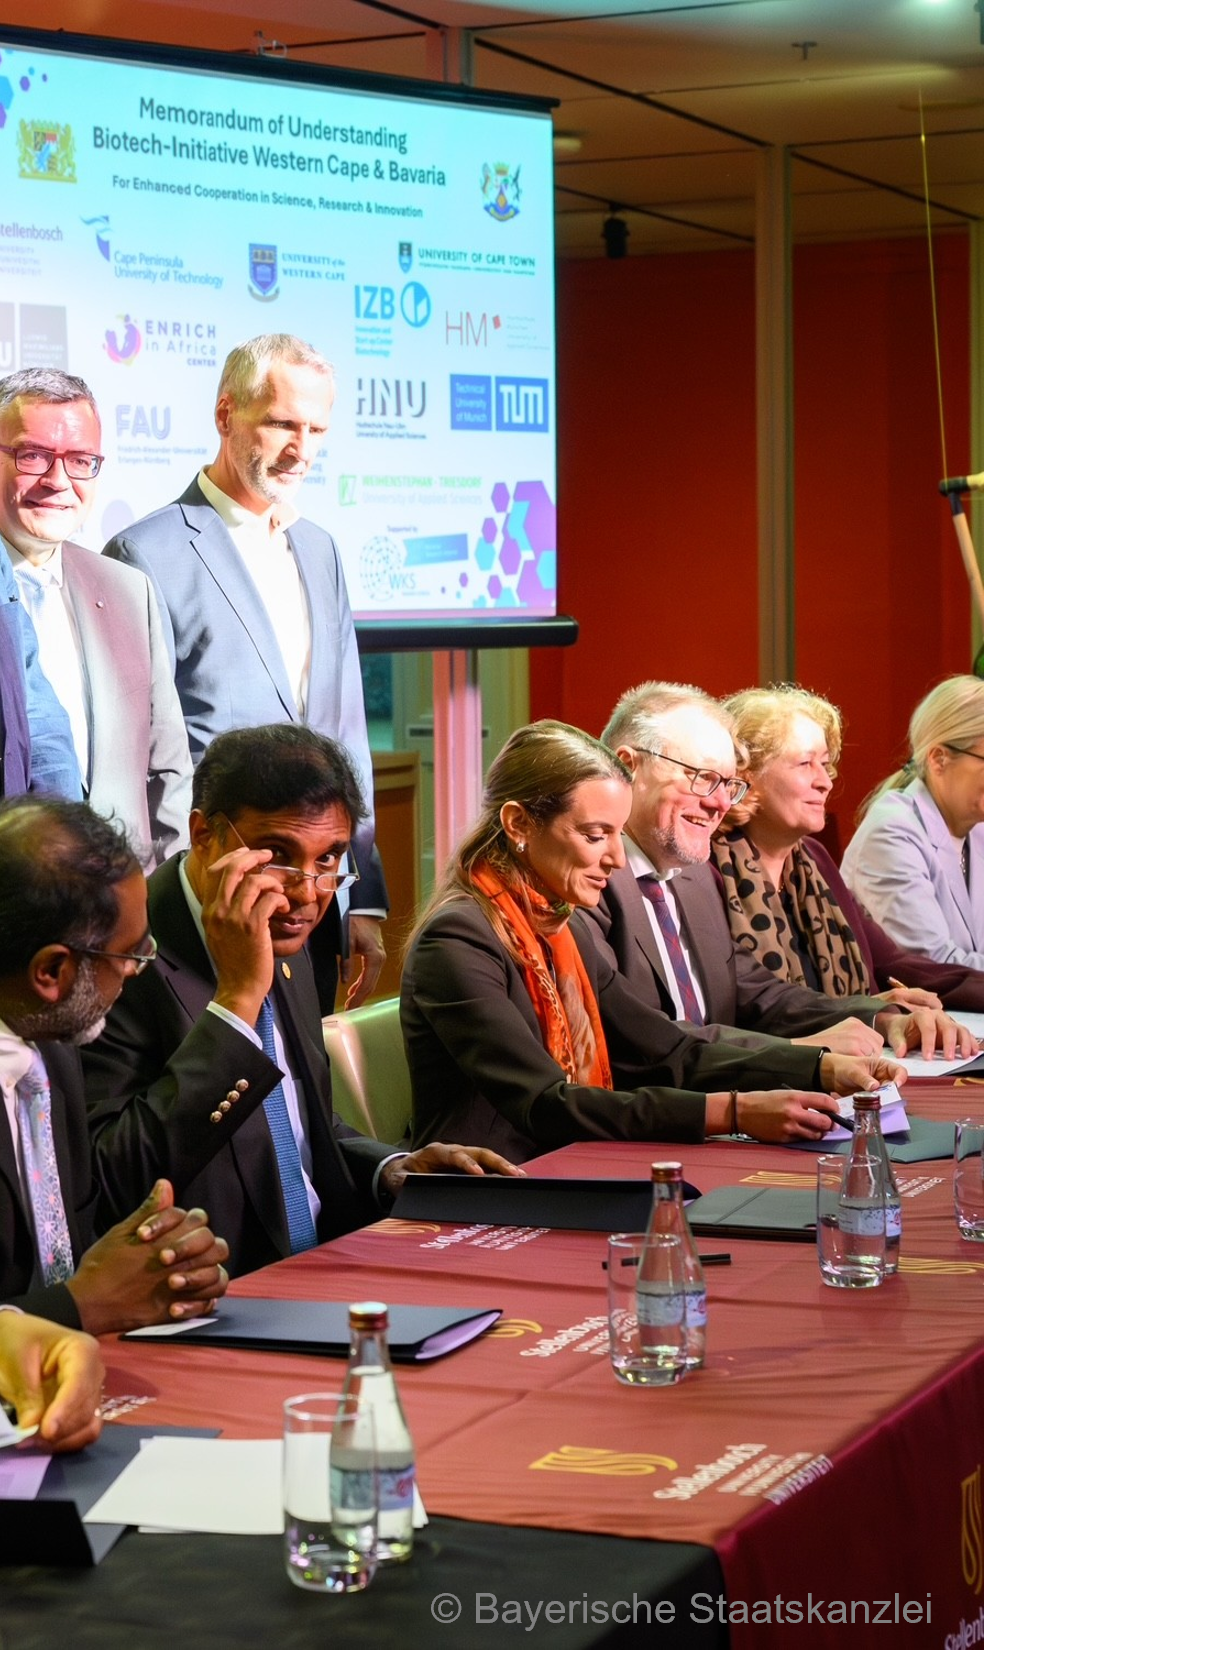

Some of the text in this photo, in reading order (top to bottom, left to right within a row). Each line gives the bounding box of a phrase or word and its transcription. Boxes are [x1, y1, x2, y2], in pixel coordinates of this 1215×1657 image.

[139, 97, 408, 154] Memorandum of Understanding
[93, 126, 446, 186] Biotech-Initiative Western Cape & Bavaria
[112, 175, 423, 218] For Enhanced Cooperation in Science, Research & Innovation
[114, 251, 183, 269] Cape Peninsula
[282, 253, 331, 266] UNIVERSITY
[418, 248, 536, 267] UNIVERSITY OF CAPE TOWN
[114, 266, 224, 290] University of Technology
[282, 268, 346, 281] WESTERN CAPE
[354, 285, 395, 320] IZB
[145, 320, 216, 339] ENRICH
[445, 311, 488, 347] HM
[145, 338, 217, 356] in Africa
[187, 358, 216, 367] CENTER
[356, 378, 426, 418] HNU
[455, 383, 485, 394] Technical
[456, 398, 486, 410] University
[499, 384, 544, 425] TUM
[115, 404, 171, 440] FAU
[456, 413, 487, 422] of Munich
[389, 573, 416, 590] WKS
